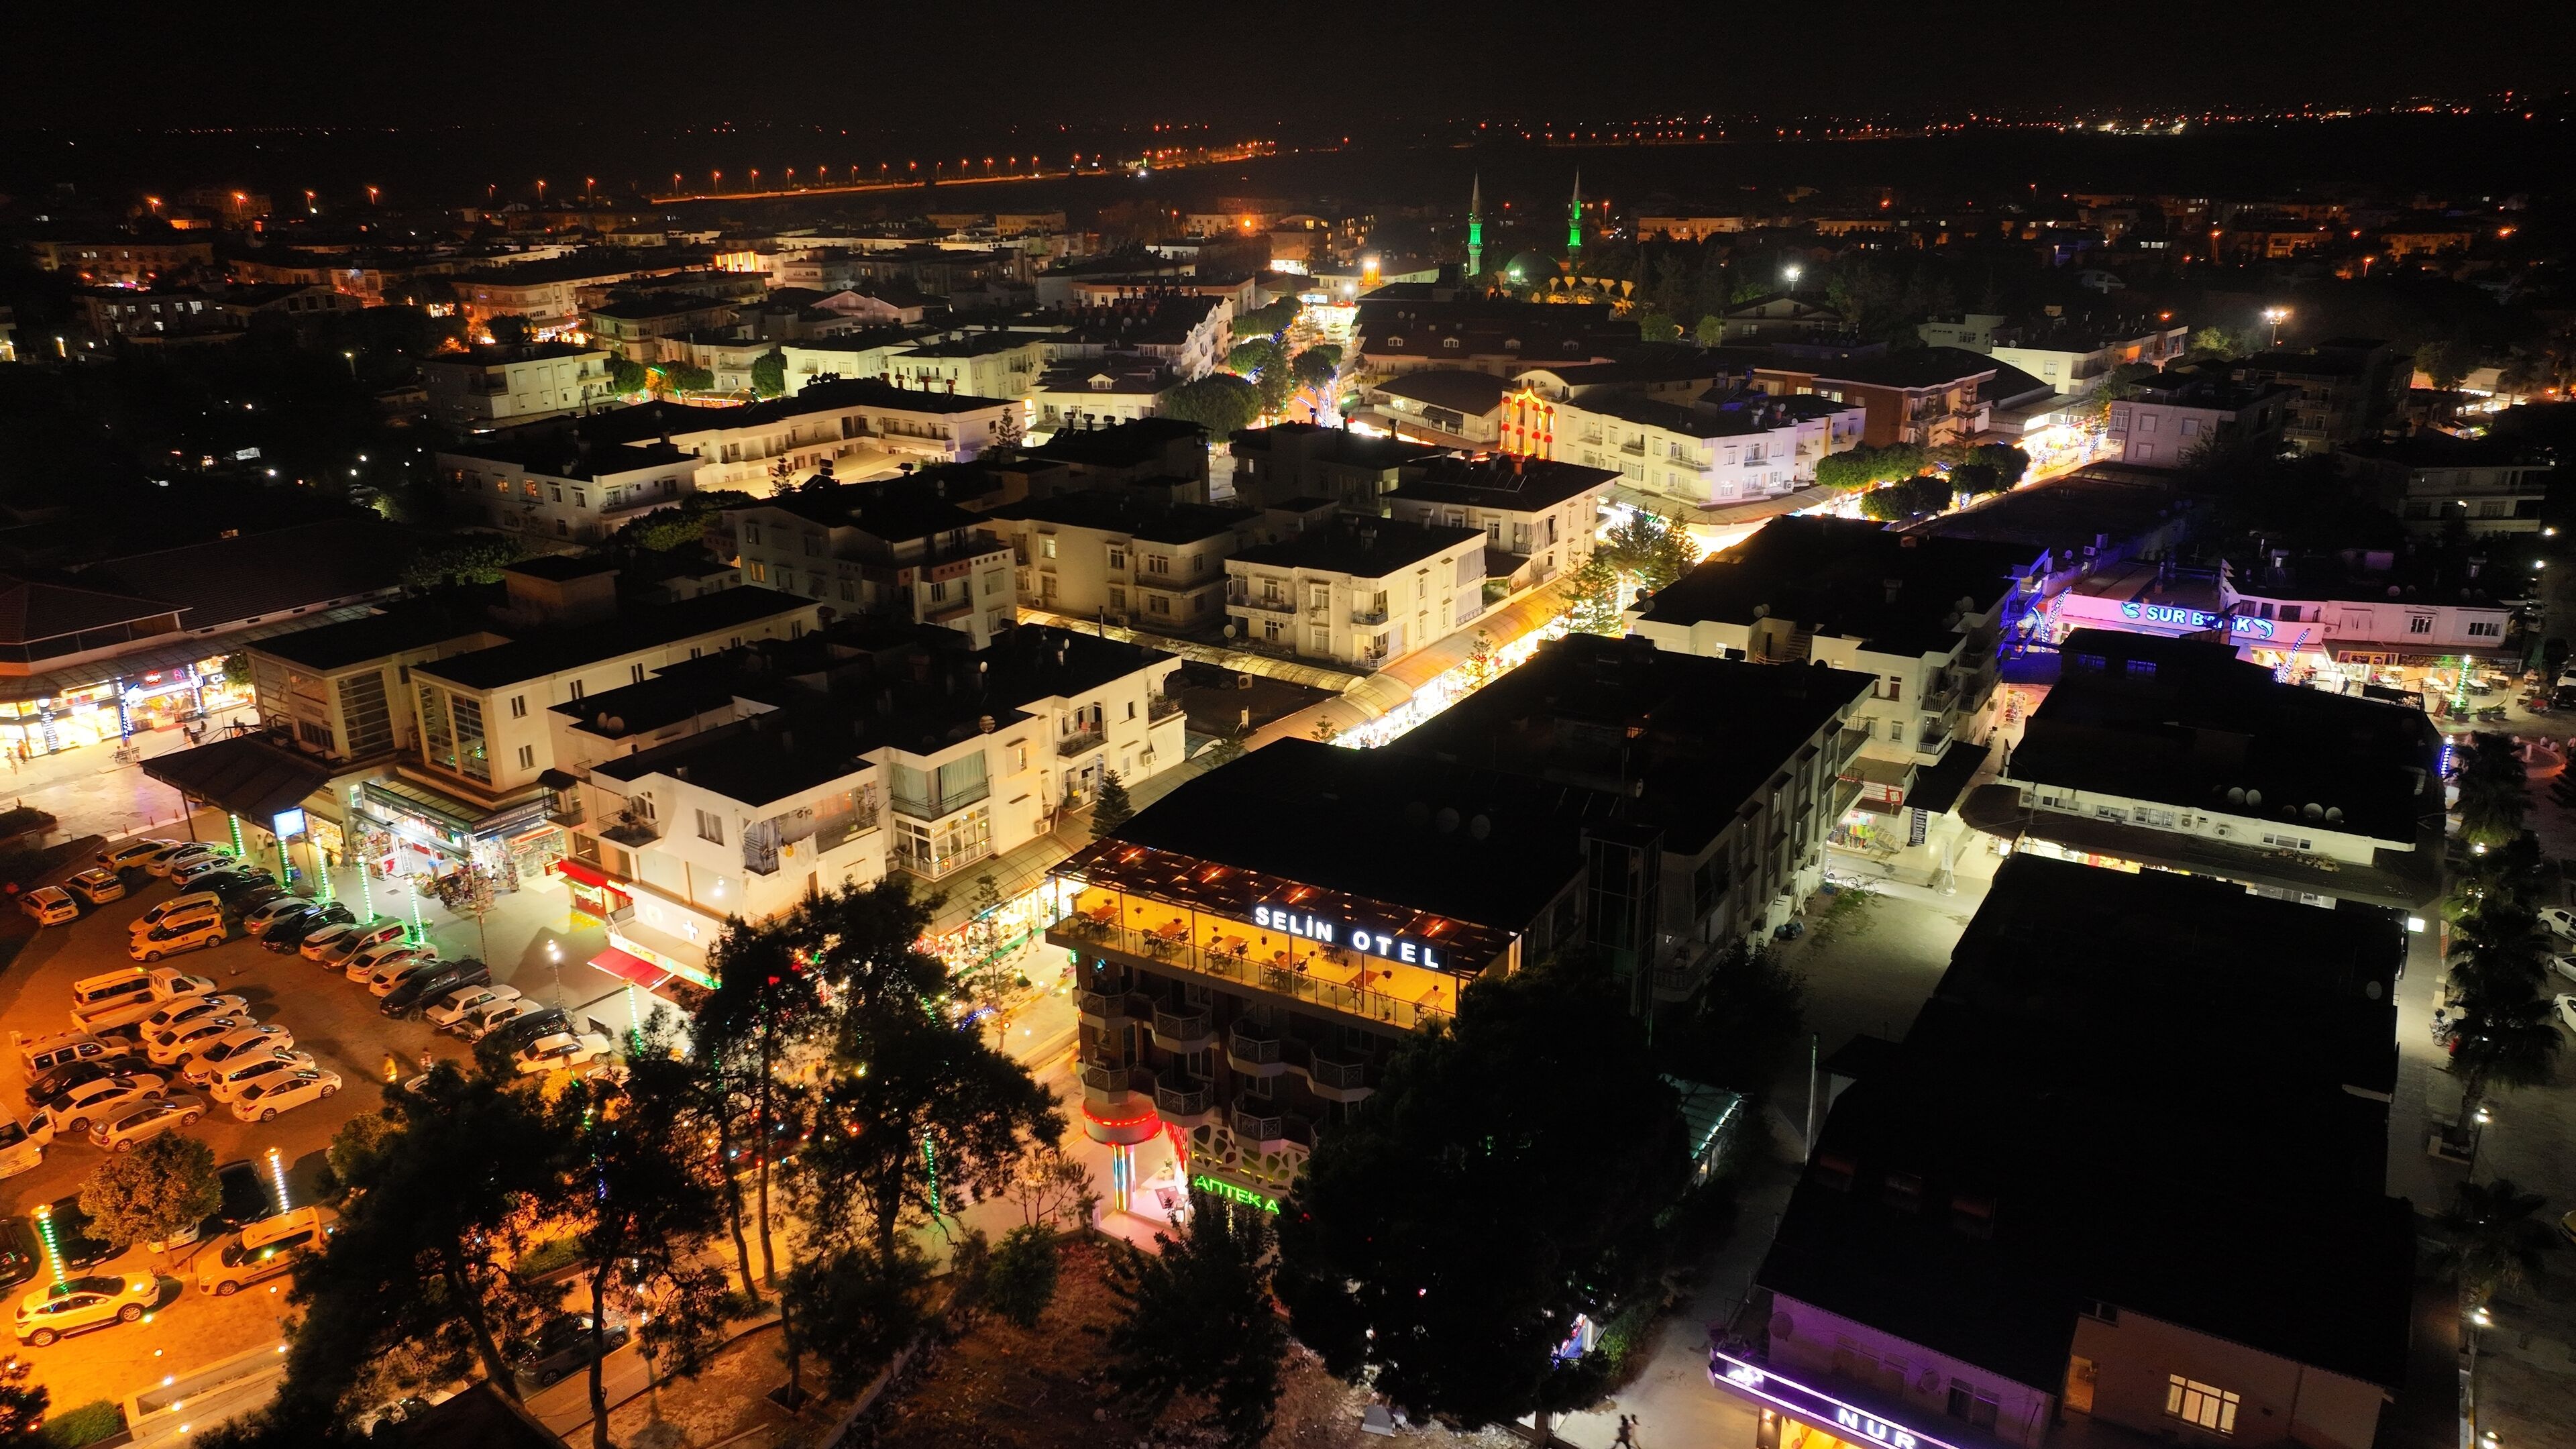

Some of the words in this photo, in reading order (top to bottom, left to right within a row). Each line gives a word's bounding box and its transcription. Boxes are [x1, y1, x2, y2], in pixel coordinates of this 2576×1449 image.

[2146, 606, 2187, 624] SUR
[1255, 906, 1333, 943] SELİN
[1352, 930, 1439, 969] OTEL
[1838, 1407, 1916, 1449] NUR
